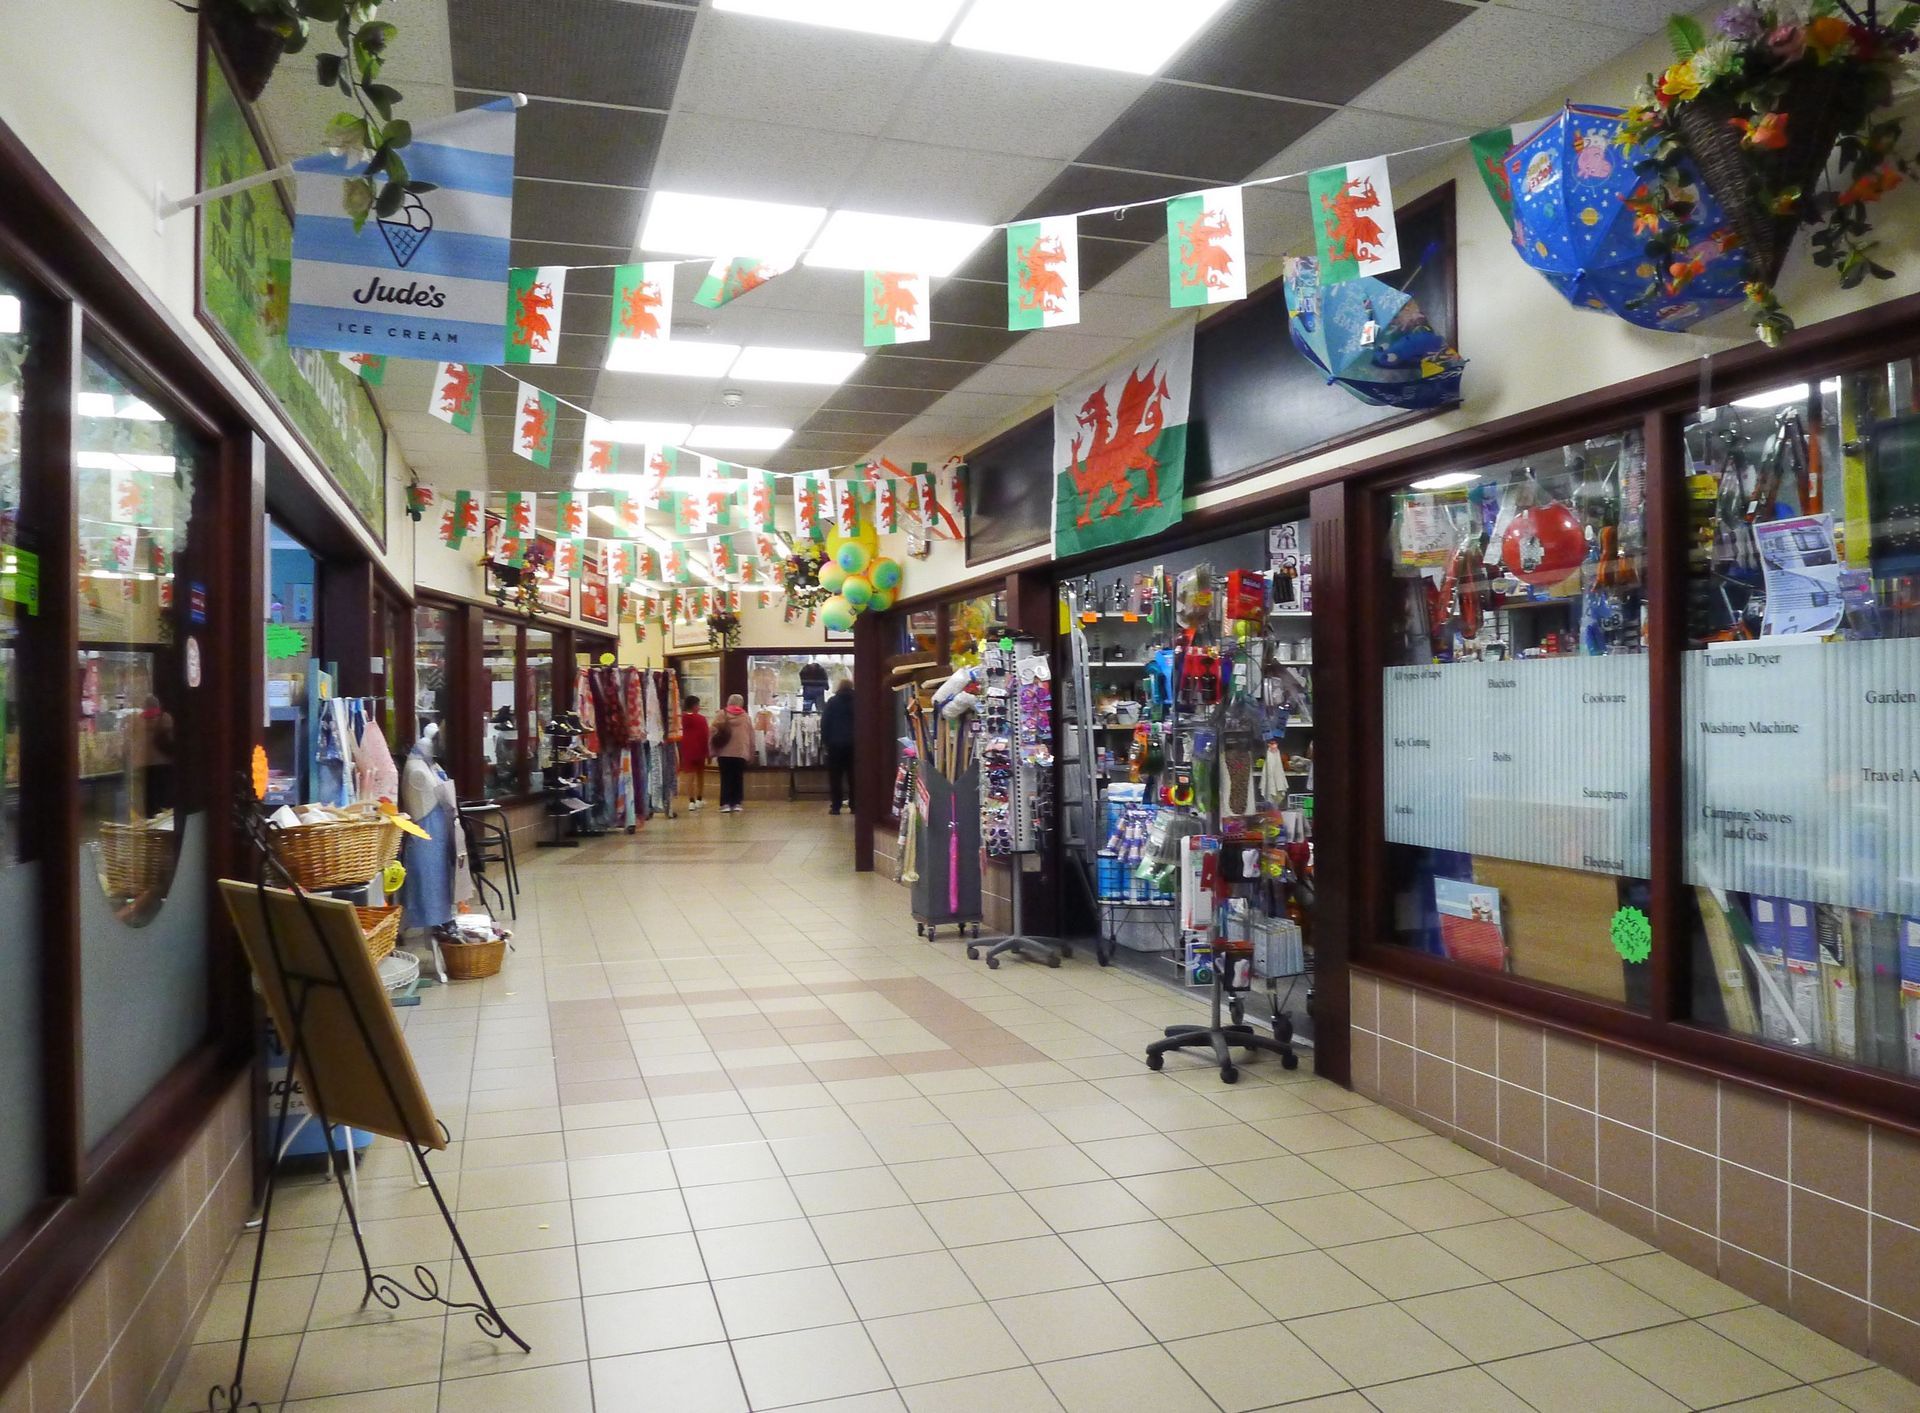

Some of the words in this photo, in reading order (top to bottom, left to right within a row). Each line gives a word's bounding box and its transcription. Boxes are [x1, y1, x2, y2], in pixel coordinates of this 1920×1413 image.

[353, 276, 446, 309] Jude's
[337, 322, 373, 335] ICE
[387, 327, 459, 343] CREAM
[1704, 654, 1745, 668] Tumble
[1748, 653, 1781, 667] Dryer
[1487, 678, 1517, 689] Buckets
[1582, 692, 1627, 704] Cookware
[1865, 690, 1917, 704] Garden
[1700, 722, 1746, 738] Washing
[1749, 721, 1800, 734] Machine
[1492, 752, 1512, 762] Bolts
[1861, 767, 1904, 782] Travel
[1582, 787, 1628, 802] Saucepans
[1702, 806, 1750, 824] Camping
[1753, 809, 1793, 824] Stoves
[1723, 828, 1744, 840] and
[1747, 828, 1769, 842] Gas
[1582, 855, 1625, 871] Electrical
